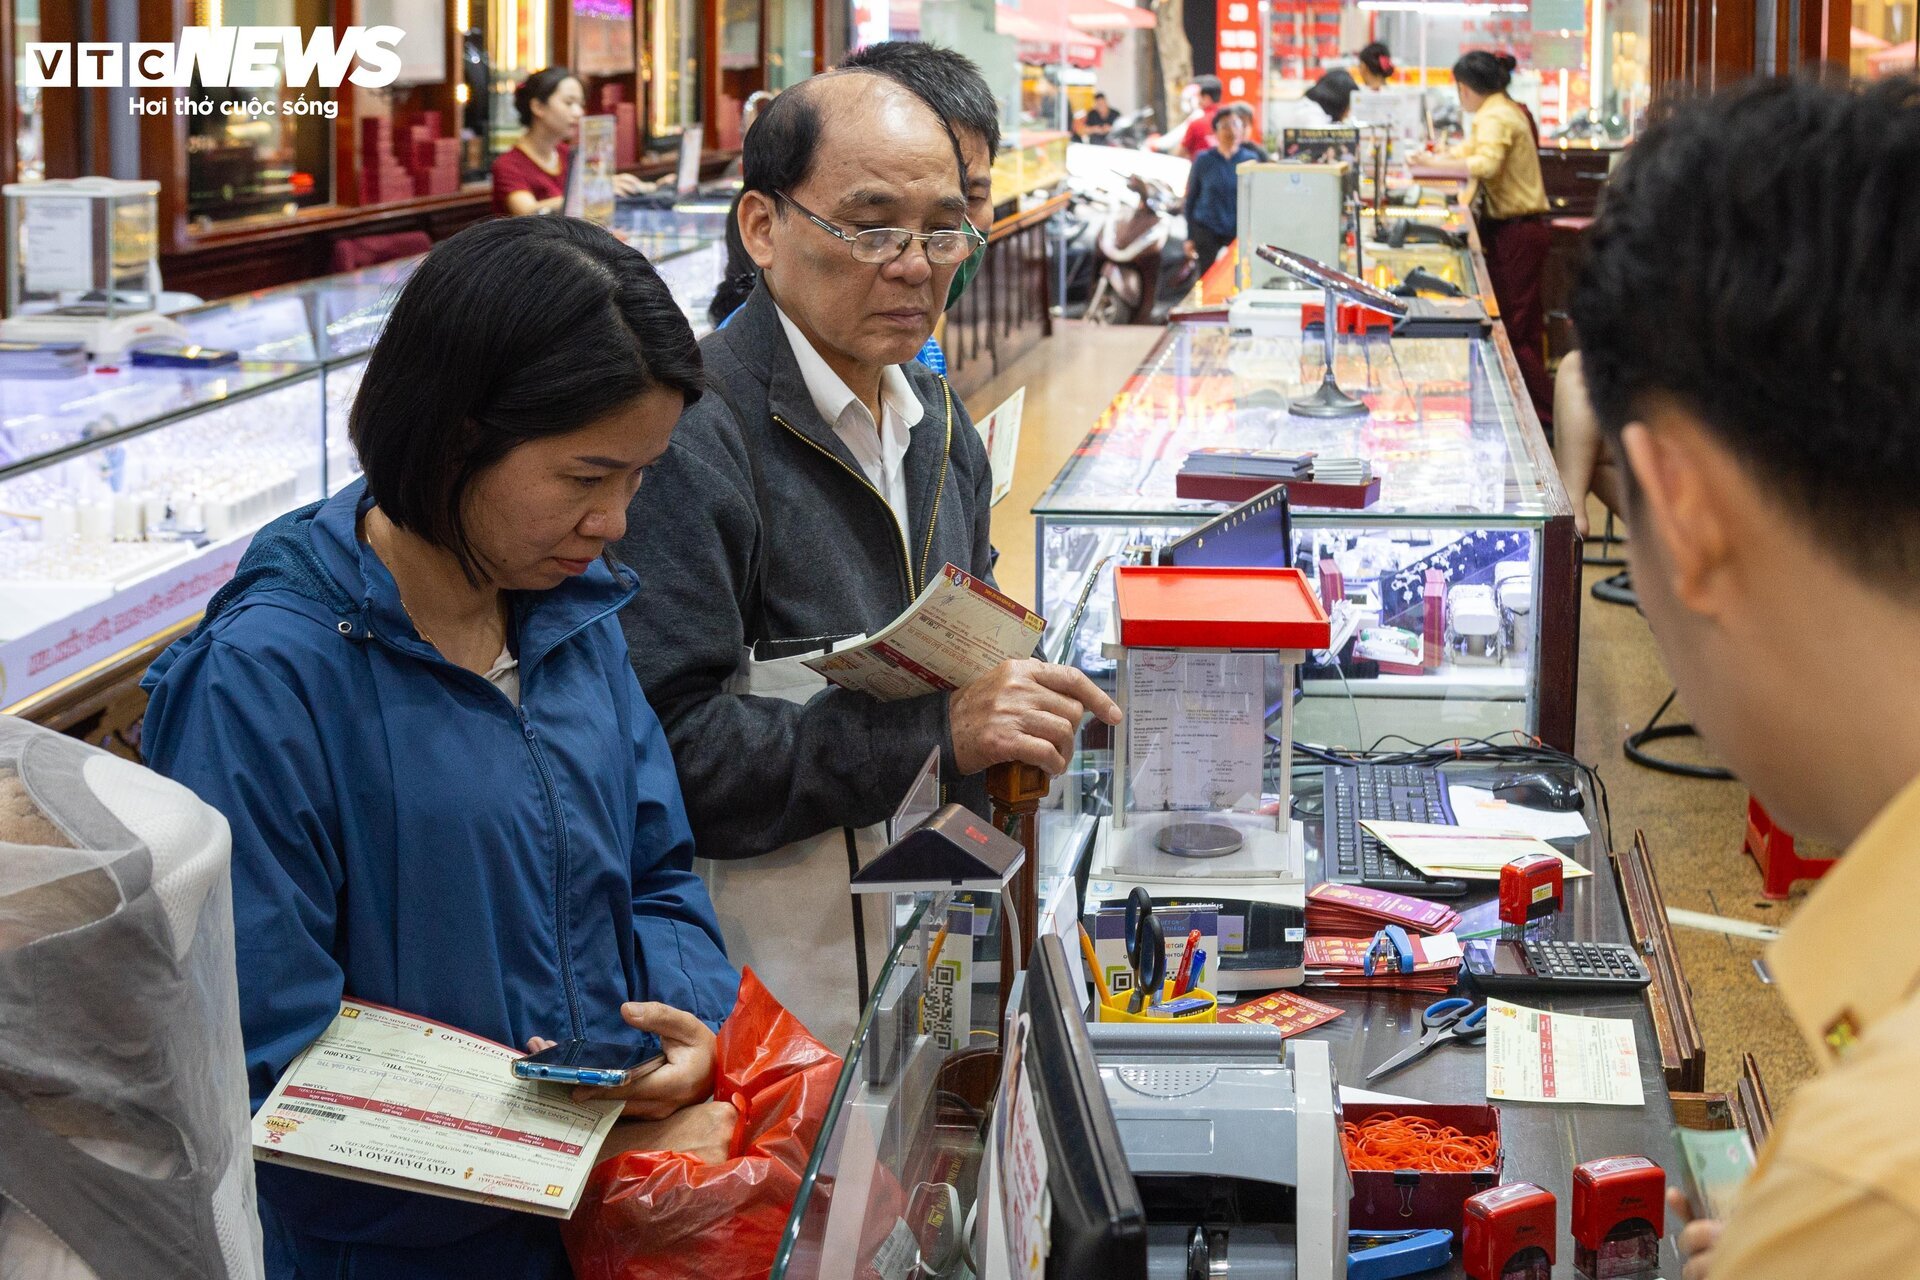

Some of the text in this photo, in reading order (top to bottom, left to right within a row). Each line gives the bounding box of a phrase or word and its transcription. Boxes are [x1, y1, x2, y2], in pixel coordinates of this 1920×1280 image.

[323, 1048, 361, 1062] 7.533.000
[328, 1143, 363, 1158] VÀNG
[365, 1150, 392, 1164] BẢO
